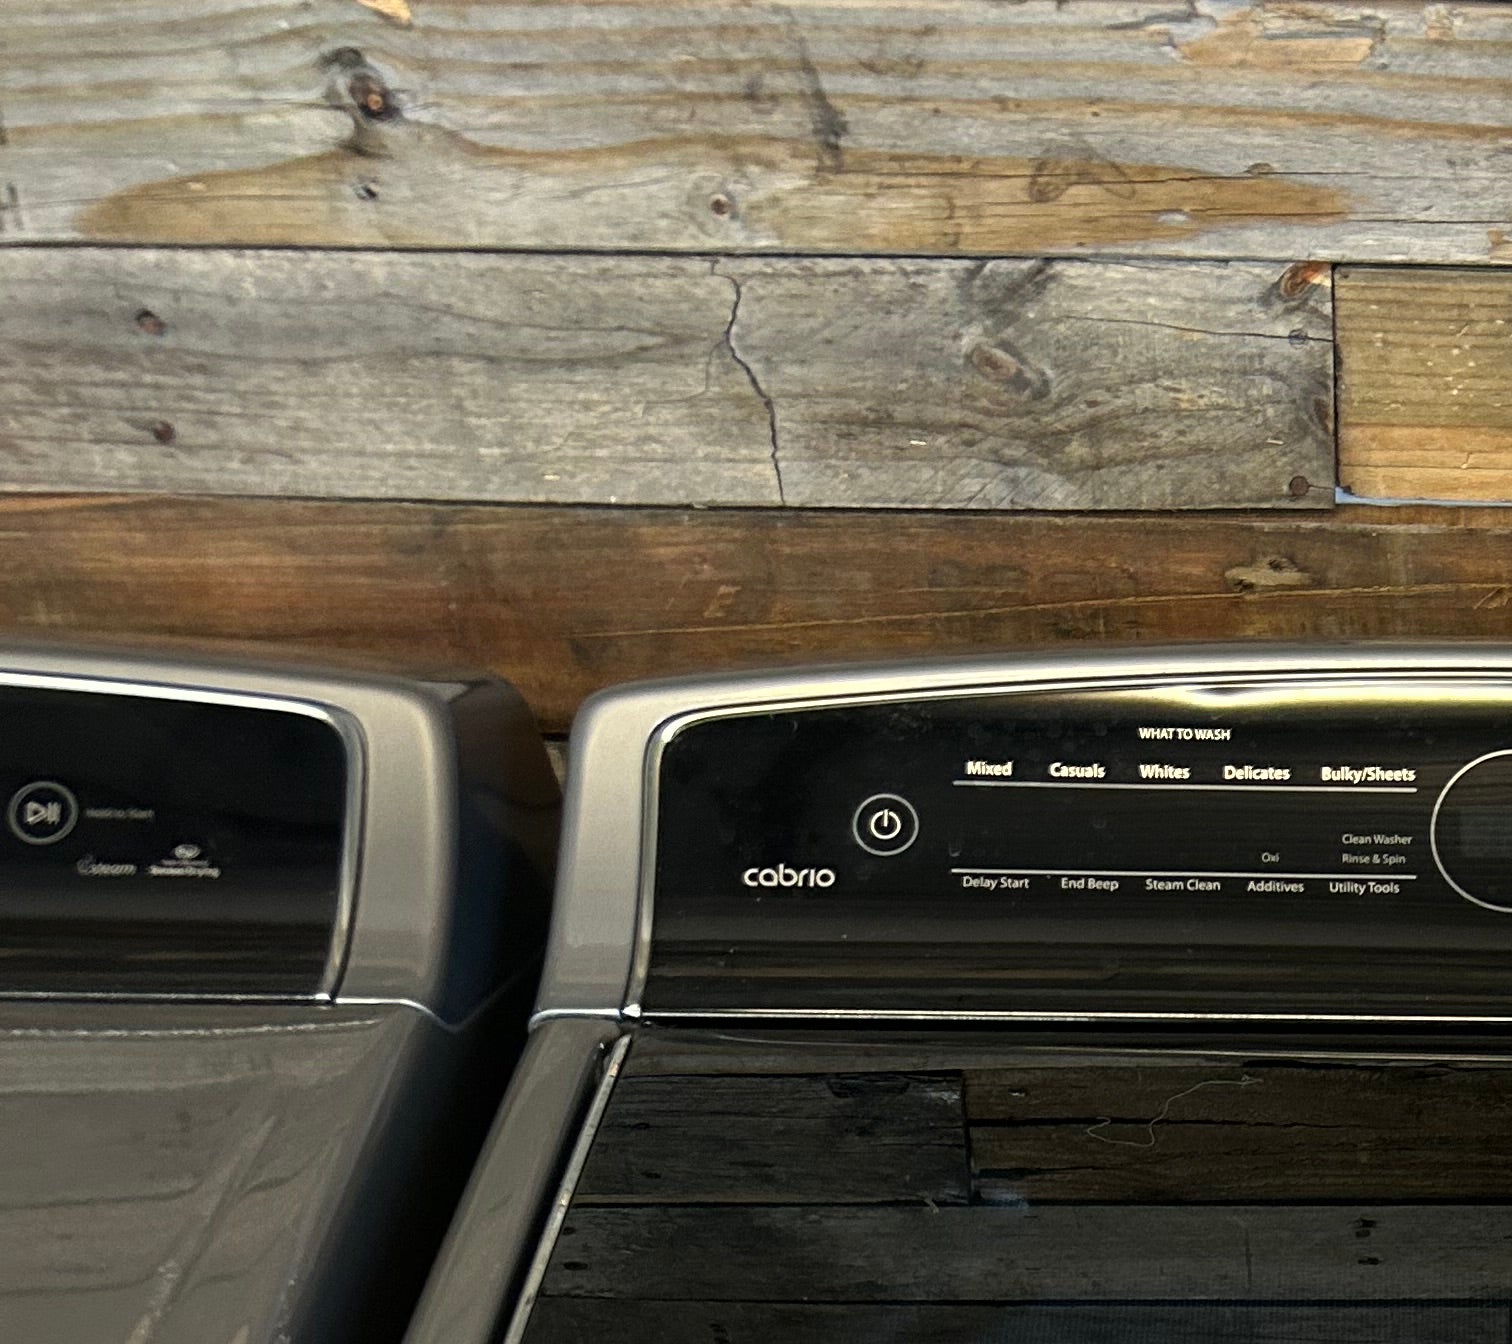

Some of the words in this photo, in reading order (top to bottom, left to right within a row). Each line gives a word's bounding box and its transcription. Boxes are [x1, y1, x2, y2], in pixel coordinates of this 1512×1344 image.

[1138, 727, 1175, 740] WHAT
[1175, 727, 1194, 741] TO
[1194, 728, 1231, 741] WASH
[965, 760, 1014, 777] Mixed
[1048, 761, 1106, 779] Casuals
[1138, 763, 1191, 780] Whites
[1223, 764, 1291, 781] Delicates
[1321, 765, 1417, 785] Bulky/Sheets
[1341, 833, 1372, 845] Clean
[1373, 834, 1413, 845] Washer
[1261, 851, 1280, 863] Oxi
[1341, 853, 1371, 864] Rinse
[1382, 853, 1407, 866] Spin
[743, 863, 836, 888] cabrio
[962, 875, 999, 891] Delay
[999, 876, 1030, 889] Start
[1061, 876, 1086, 890] End
[1087, 877, 1120, 892] Beep
[1145, 878, 1185, 891] Steam
[1186, 878, 1221, 891] Clean
[1246, 880, 1305, 893] Additives
[1329, 881, 1367, 896] Utility
[1368, 881, 1400, 894] Tools
